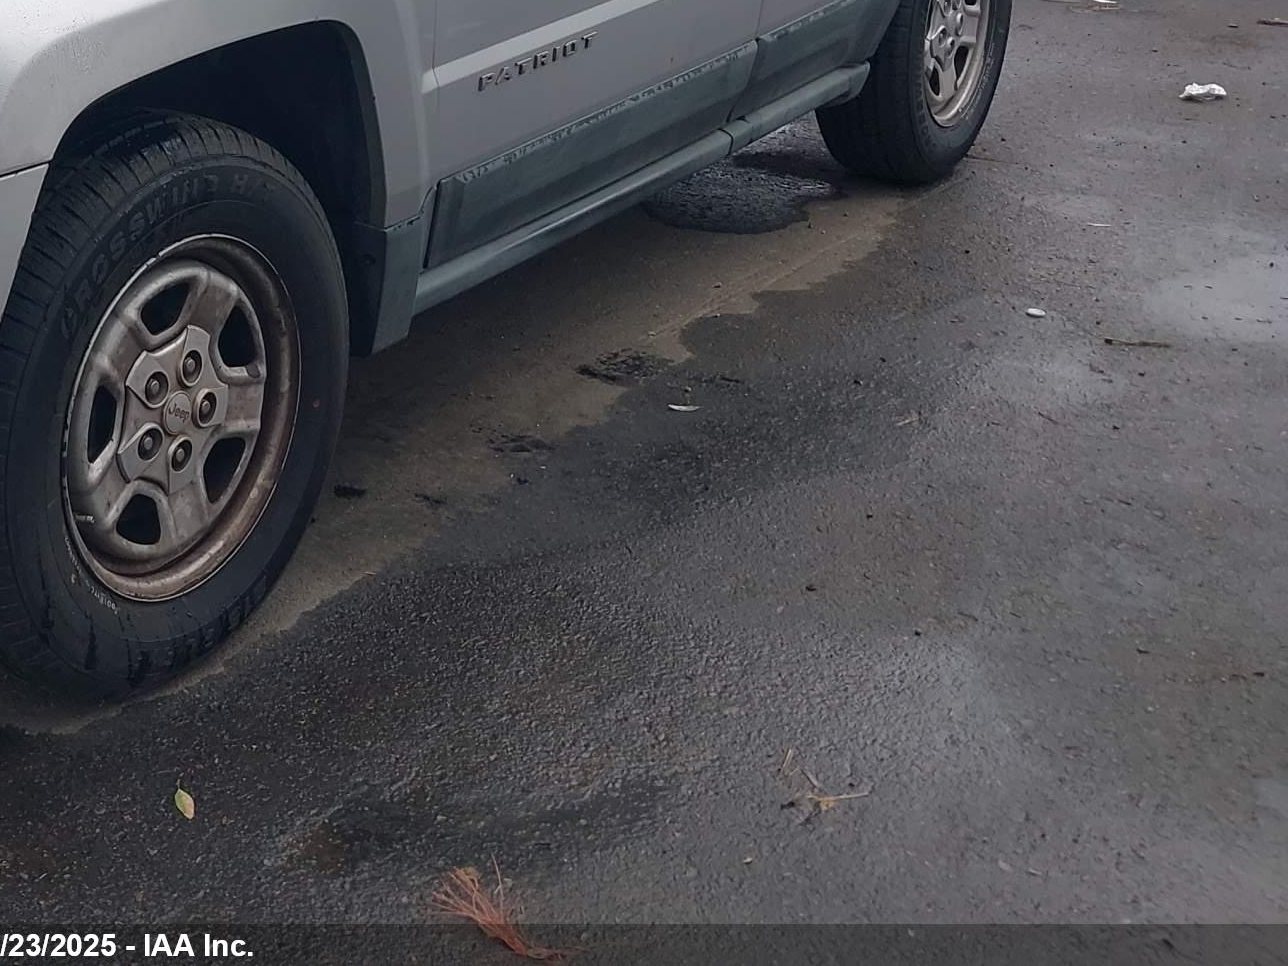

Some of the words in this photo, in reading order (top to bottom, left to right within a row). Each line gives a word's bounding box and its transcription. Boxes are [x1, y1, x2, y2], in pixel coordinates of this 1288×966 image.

[477, 30, 599, 93] PATRIOT
[60, 172, 220, 341] CROSSWIND
[168, 402, 190, 424] Jeep
